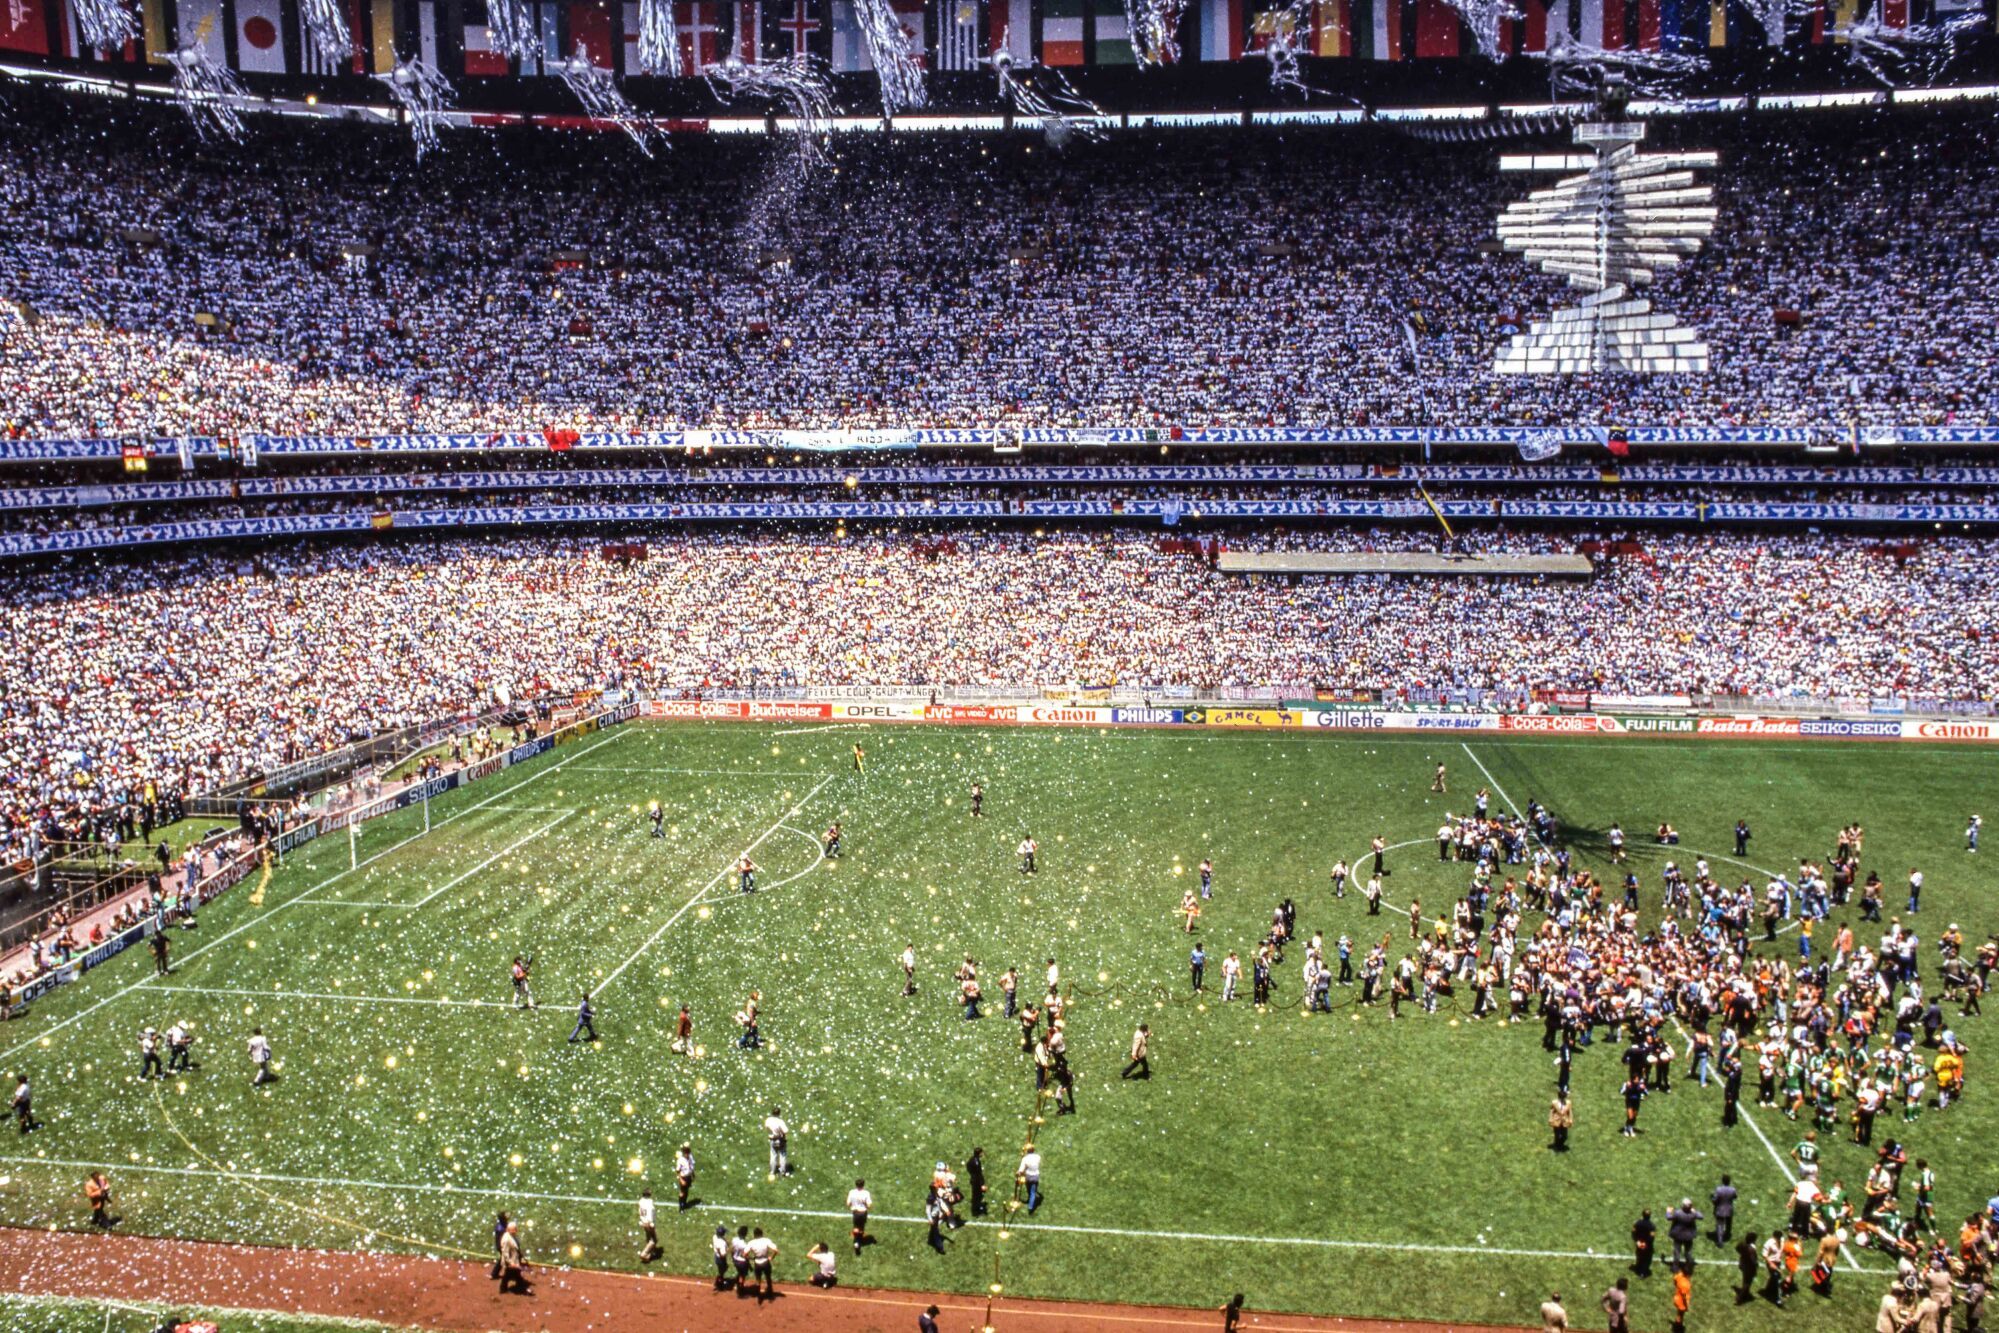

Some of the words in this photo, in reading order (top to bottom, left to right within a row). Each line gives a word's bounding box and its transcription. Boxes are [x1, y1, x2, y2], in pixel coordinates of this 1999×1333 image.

[664, 702, 727, 717] Coca-Cola
[749, 702, 822, 718] Budweiser
[847, 705, 897, 718] OPEL
[925, 706, 953, 719] JVC
[989, 708, 1017, 720] JVC
[1032, 707, 1096, 722] Canon
[1118, 708, 1173, 723] PHILIPS
[1214, 710, 1263, 725] CAMEL
[1317, 711, 1385, 728] Gillette
[1513, 716, 1583, 731] Coca-Cola
[1697, 719, 1748, 733] Bata
[1749, 720, 1799, 733] Bata
[1800, 722, 1850, 734] SEIKO
[1851, 723, 1900, 735] SEIKO
[1919, 723, 1989, 737] Canon
[512, 740, 541, 762] PHILIPS
[467, 757, 502, 781] Canon
[409, 777, 448, 804] SEIKO
[86, 936, 125, 968] PHILIPS
[22, 971, 64, 1001] OPEL
